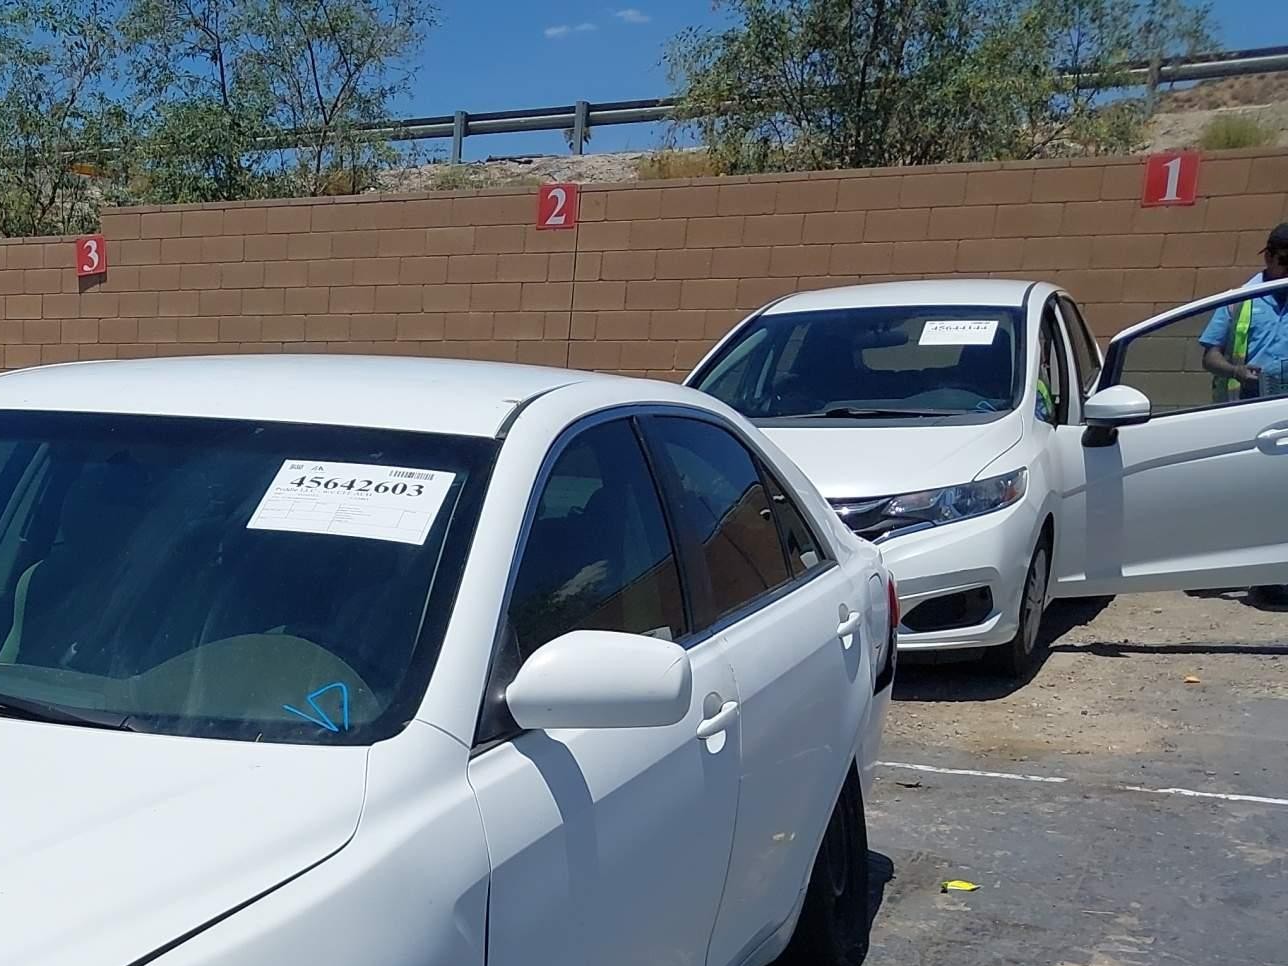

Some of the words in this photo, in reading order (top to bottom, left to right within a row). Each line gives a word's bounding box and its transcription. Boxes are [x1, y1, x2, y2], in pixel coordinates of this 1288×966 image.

[1158, 156, 1181, 202] 1
[544, 187, 567, 225] 2
[83, 239, 99, 272] 3
[289, 475, 425, 497] 45642603
